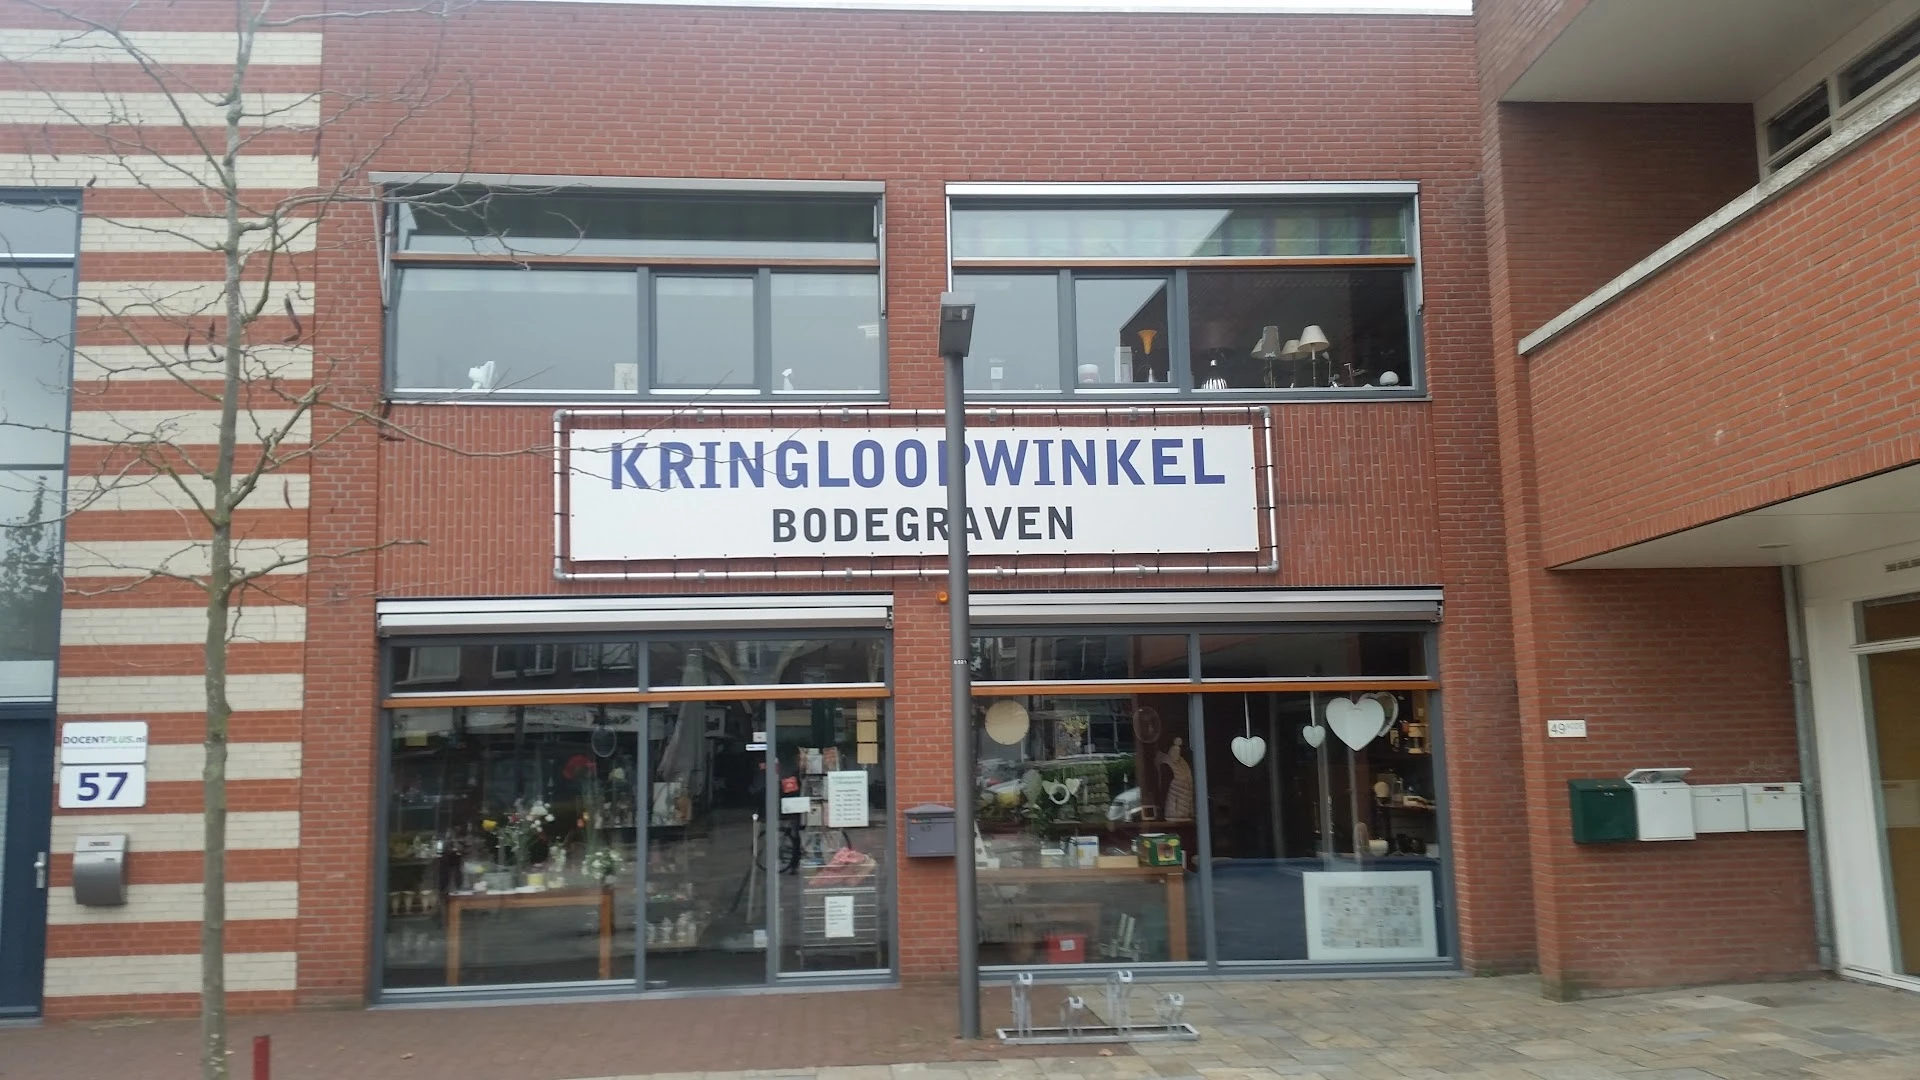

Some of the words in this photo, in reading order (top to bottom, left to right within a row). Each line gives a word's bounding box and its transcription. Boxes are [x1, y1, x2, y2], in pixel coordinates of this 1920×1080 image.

[611, 438, 1226, 490] KRINGLOOPWINKEL
[772, 505, 1074, 543] BODEGRAVEN
[1550, 722, 1565, 735] 49
[77, 771, 129, 802] 57
